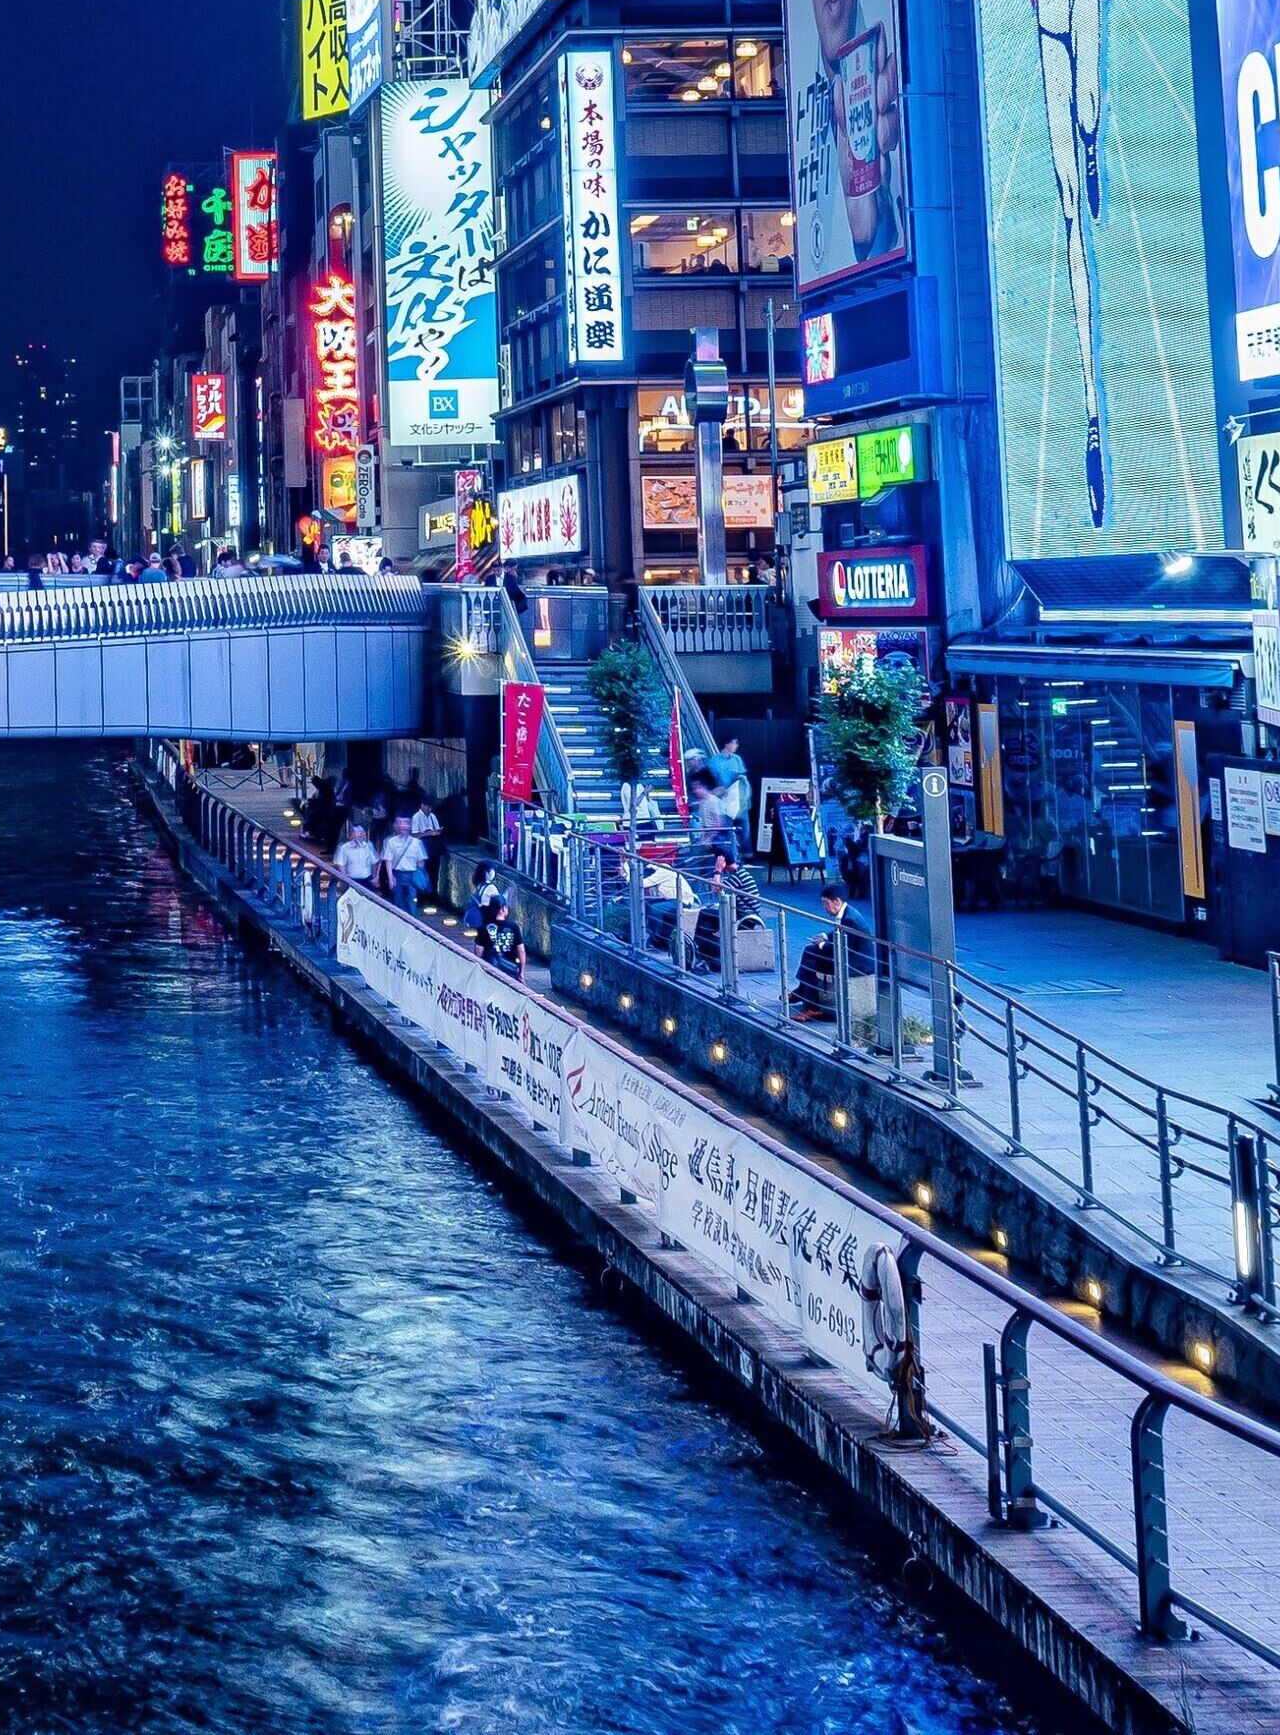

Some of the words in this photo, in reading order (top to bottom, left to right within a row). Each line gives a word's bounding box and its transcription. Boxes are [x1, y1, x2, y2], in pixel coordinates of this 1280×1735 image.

[578, 101, 607, 199] 本場の味
[166, 175, 189, 263] お好み焼
[579, 210, 615, 350] かに道楽
[196, 384, 208, 424] ドラッグ
[207, 377, 223, 415] ツルハ
[431, 396, 456, 412] BX
[409, 421, 484, 436] 文化シャッター
[358, 465, 369, 496] ZERO
[847, 563, 910, 599] LOTTERIA
